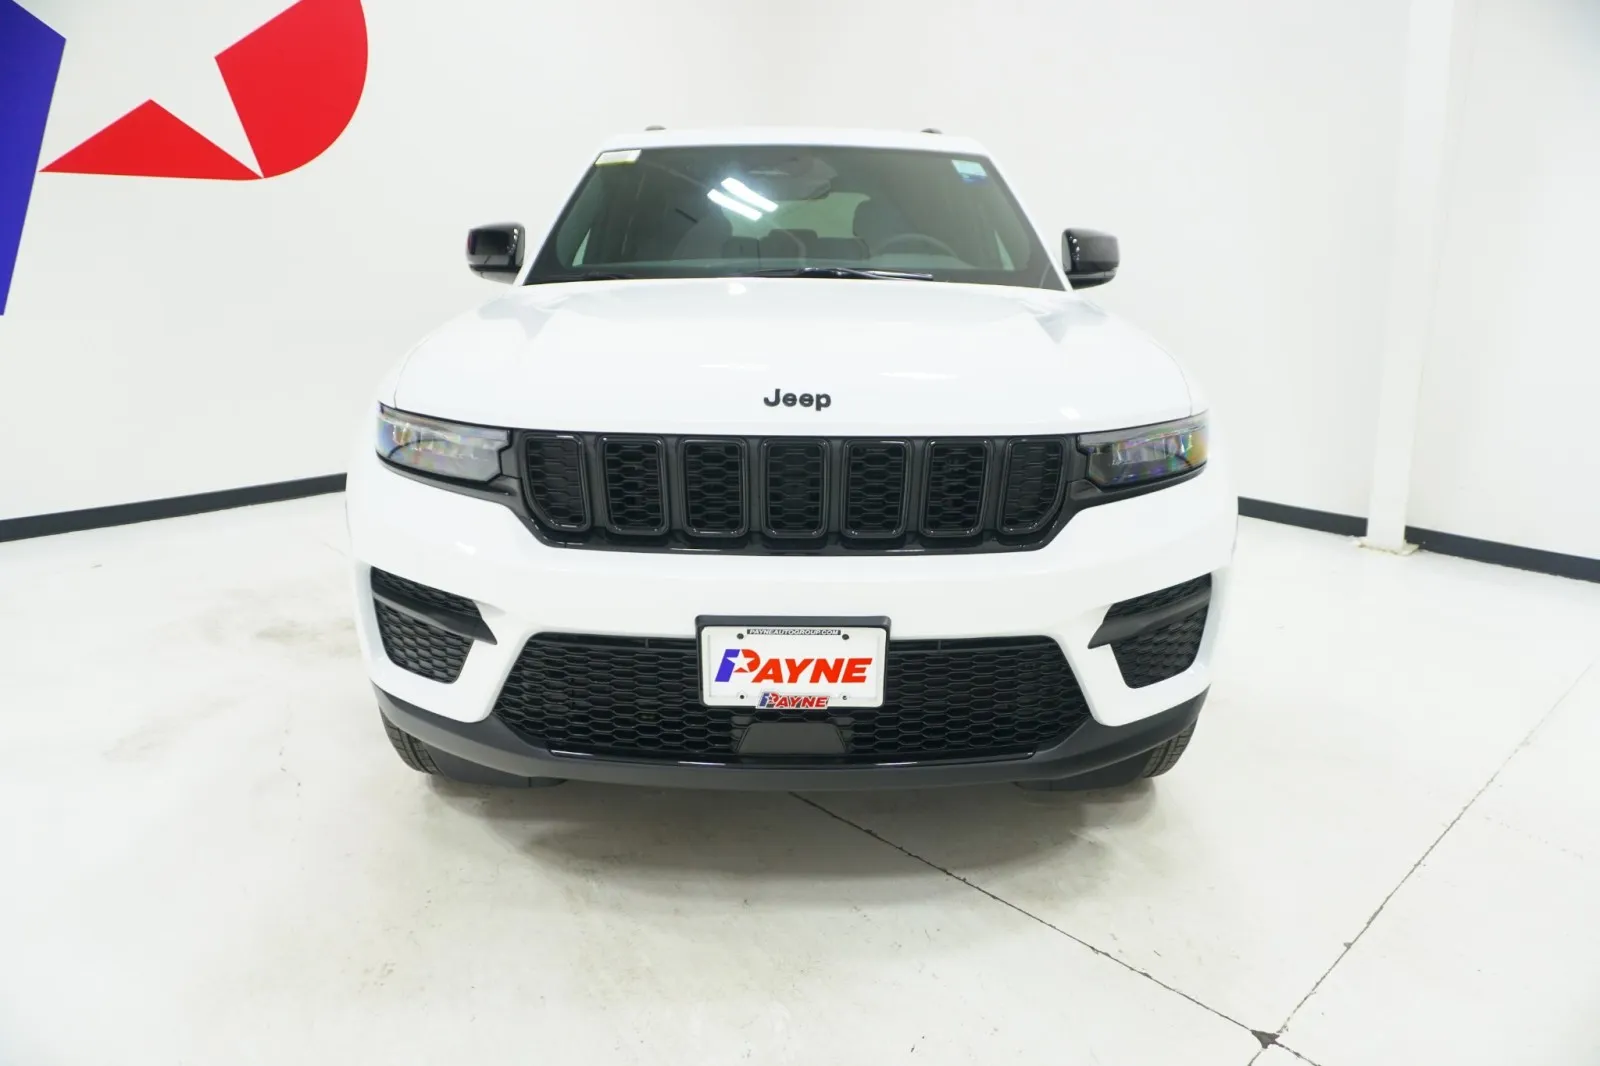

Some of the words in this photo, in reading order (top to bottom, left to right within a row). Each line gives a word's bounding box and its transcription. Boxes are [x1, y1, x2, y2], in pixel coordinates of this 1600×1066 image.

[763, 388, 832, 411] Jeep
[715, 648, 873, 684] PAYNE
[759, 692, 828, 708] PAYNE
